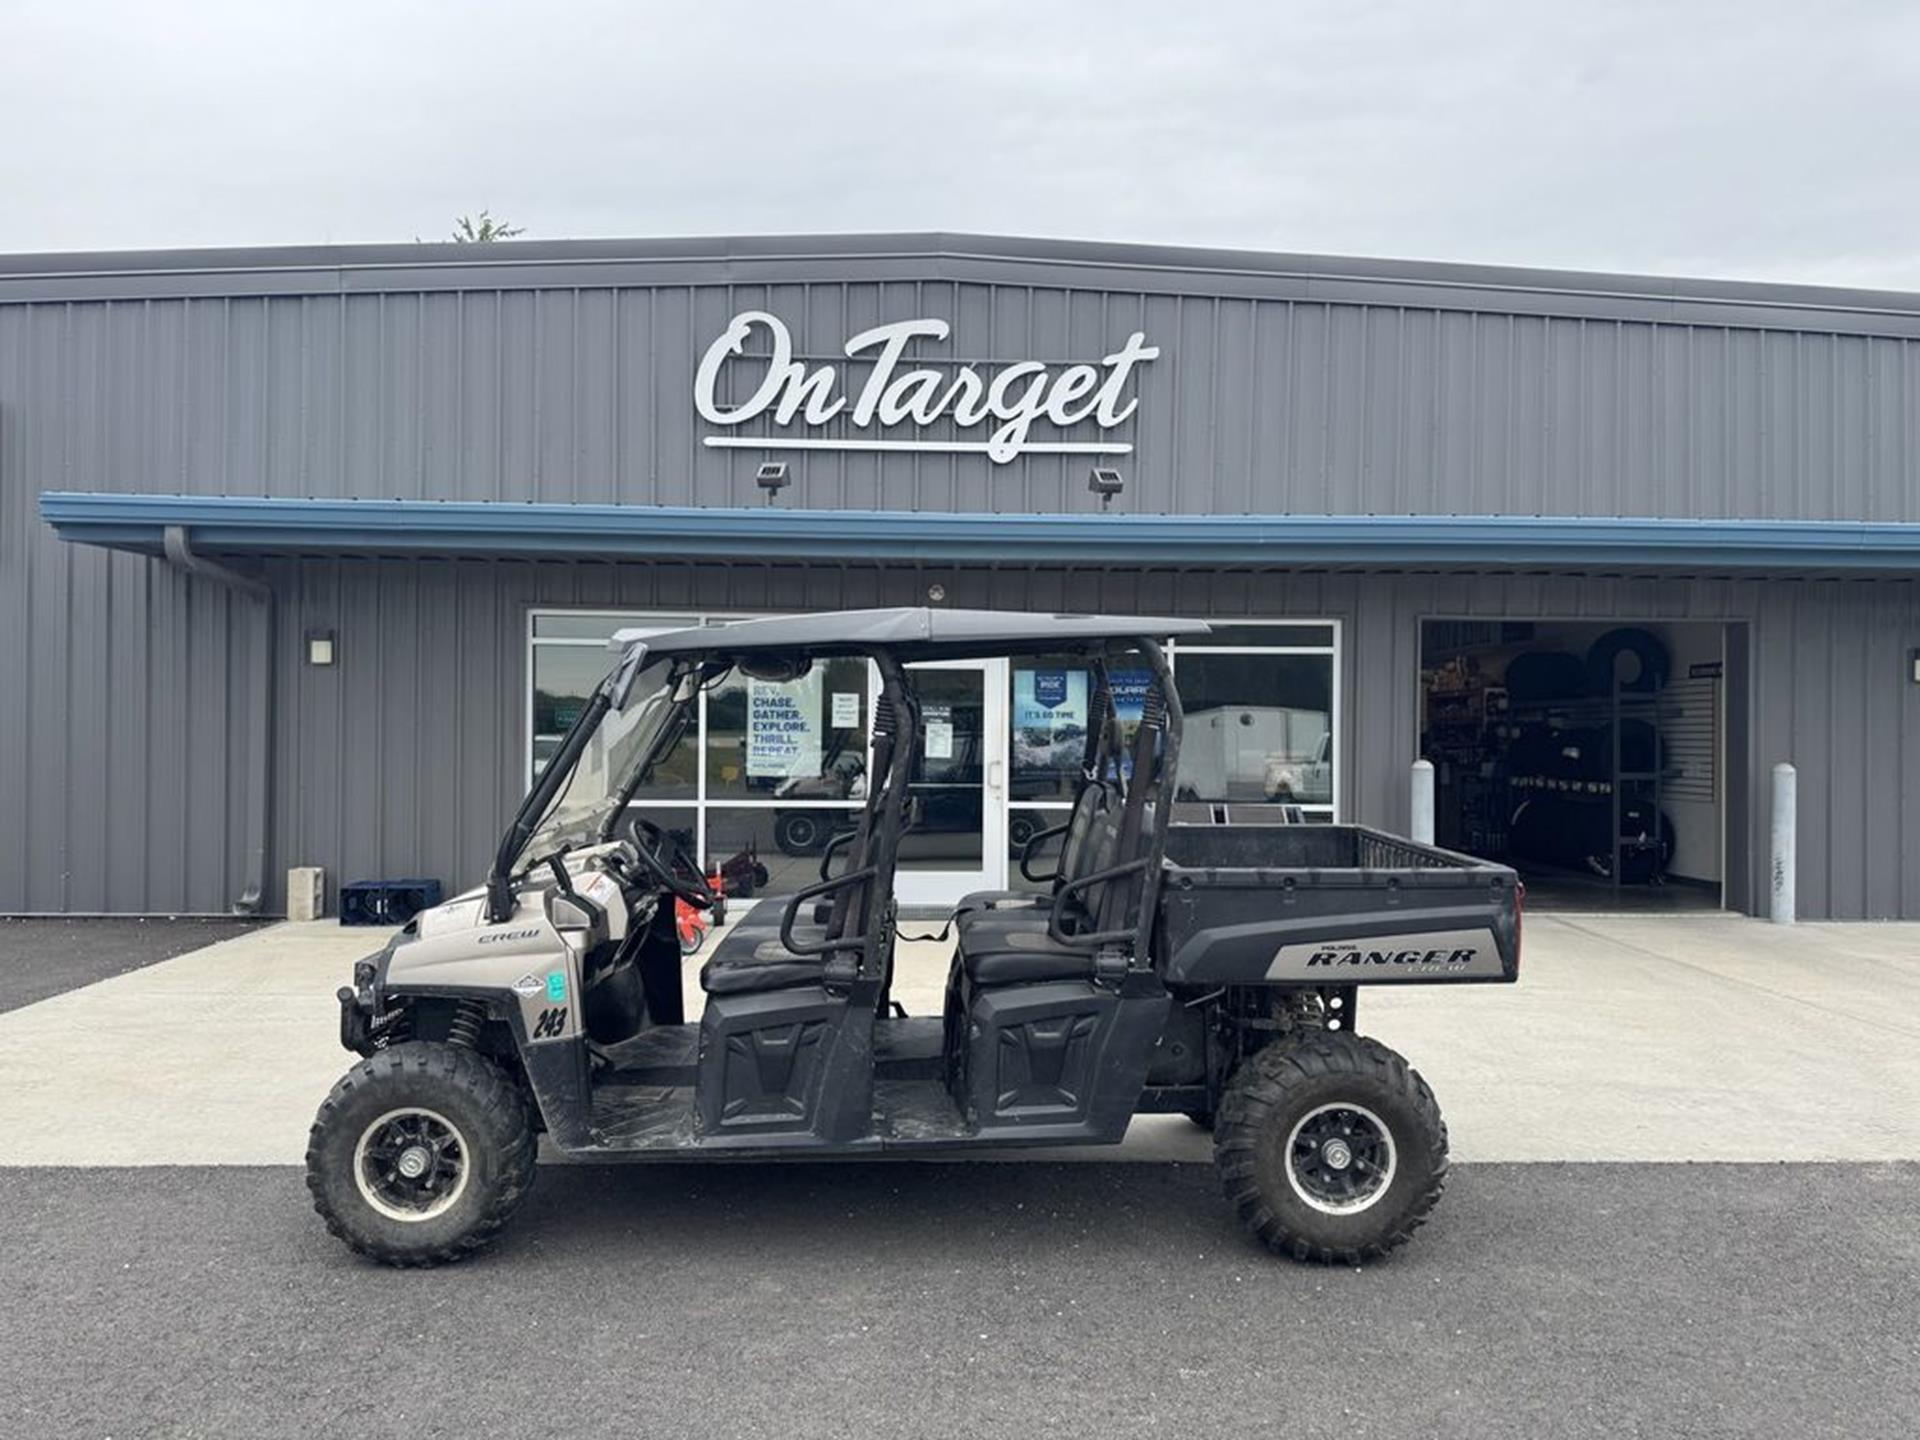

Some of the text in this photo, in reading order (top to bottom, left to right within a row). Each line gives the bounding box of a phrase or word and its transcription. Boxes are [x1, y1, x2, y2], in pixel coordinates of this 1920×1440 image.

[695, 311, 1160, 464] On Target
[753, 697, 796, 708] CHASE.
[753, 709, 804, 720] GATHER.
[1056, 711, 1074, 719] TIME
[753, 721, 811, 732] EXPLORE.
[753, 734, 798, 744] THRILL.
[479, 929, 540, 944] CREW
[1307, 949, 1477, 967] RANGER
[533, 1007, 568, 1039] 243
